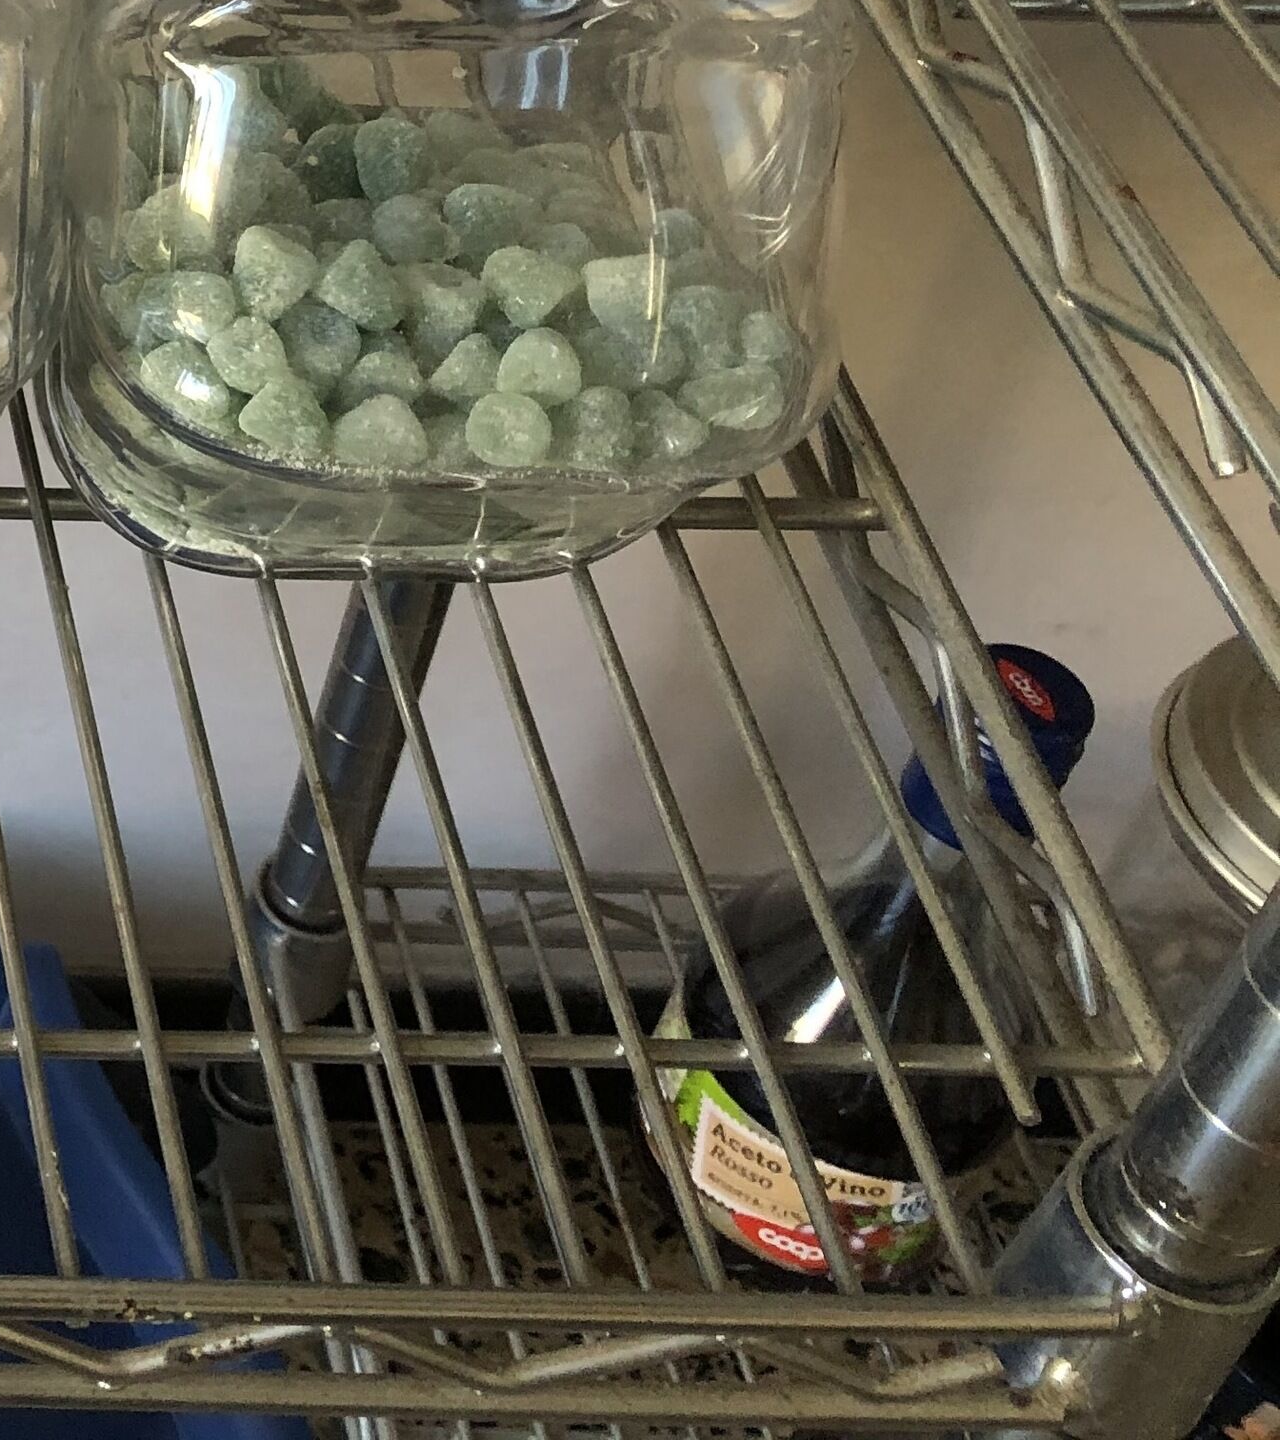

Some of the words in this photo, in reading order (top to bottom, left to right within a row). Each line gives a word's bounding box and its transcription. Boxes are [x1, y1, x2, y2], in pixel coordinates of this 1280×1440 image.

[710, 1145, 773, 1189] Rosso
[712, 1123, 782, 1173] Aceto
[758, 1227, 825, 1262] coop
